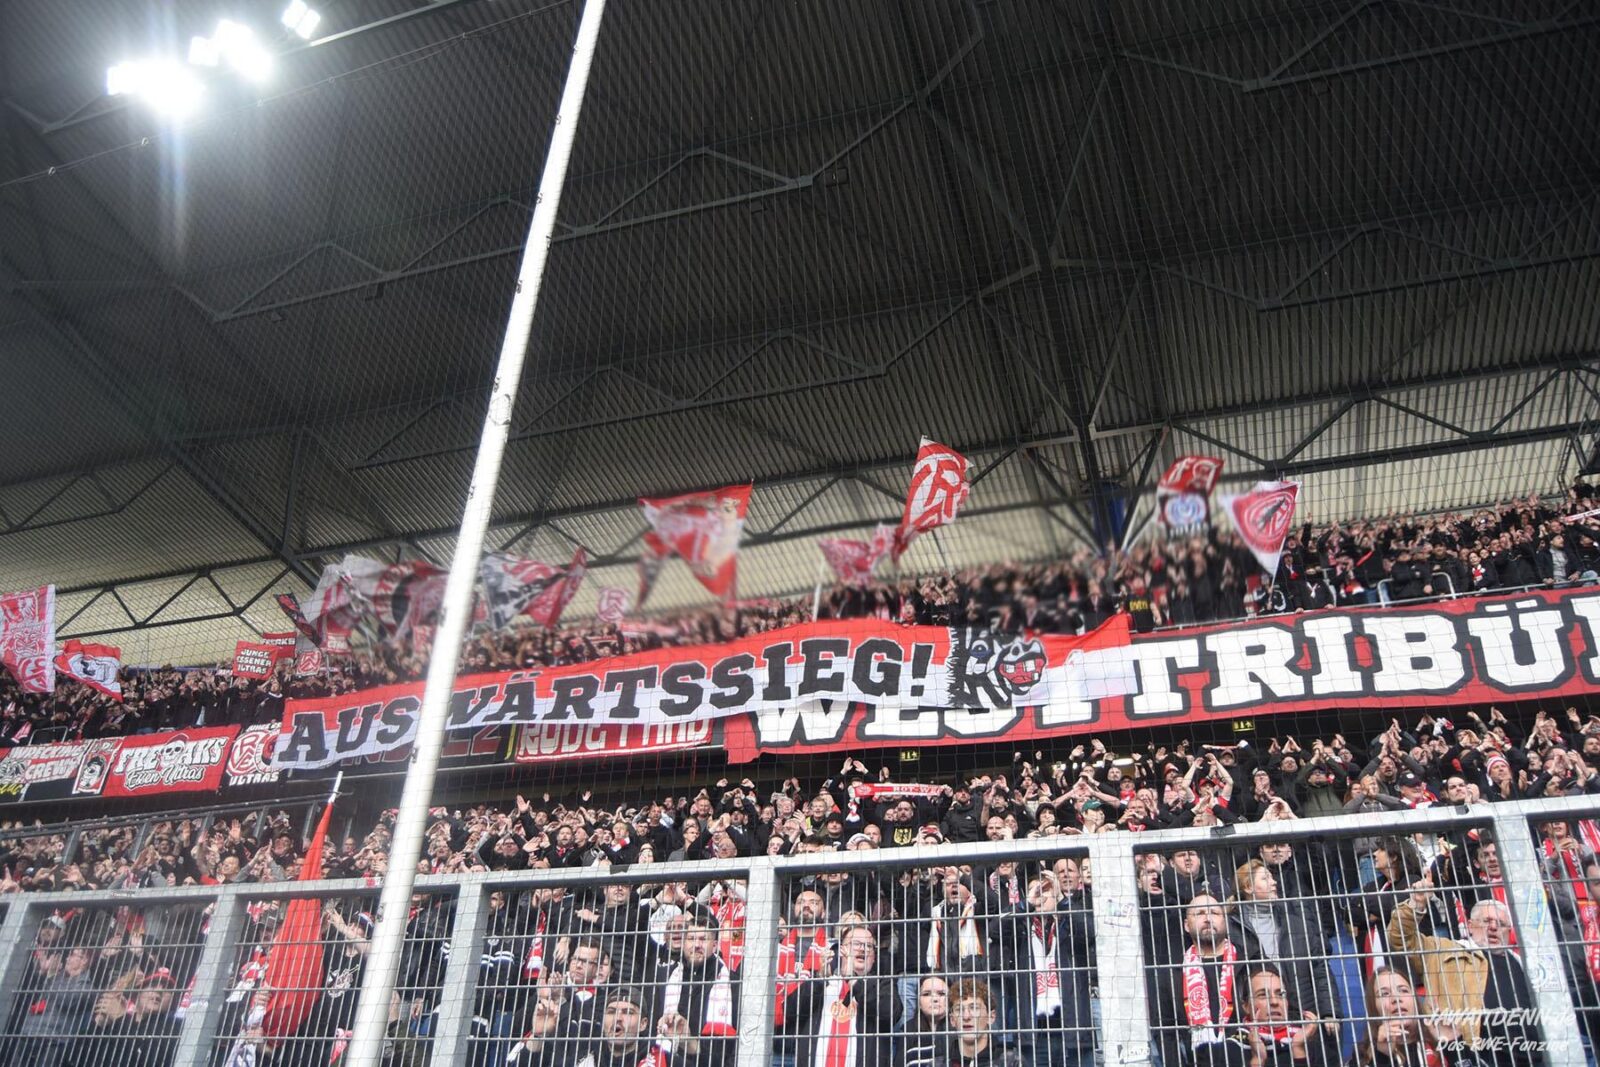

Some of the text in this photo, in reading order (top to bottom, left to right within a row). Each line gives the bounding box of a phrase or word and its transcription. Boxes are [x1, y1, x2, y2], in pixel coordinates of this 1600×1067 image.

[236, 655, 272, 668] ESSENER
[240, 648, 270, 659] JUNGE
[755, 597, 1600, 743] WTRIBÜ
[9, 743, 86, 760] WRECKING
[113, 736, 230, 775] FREAKS
[24, 759, 75, 781] CREW
[161, 765, 205, 785] Ultras
[228, 771, 280, 787] ULTRAS
